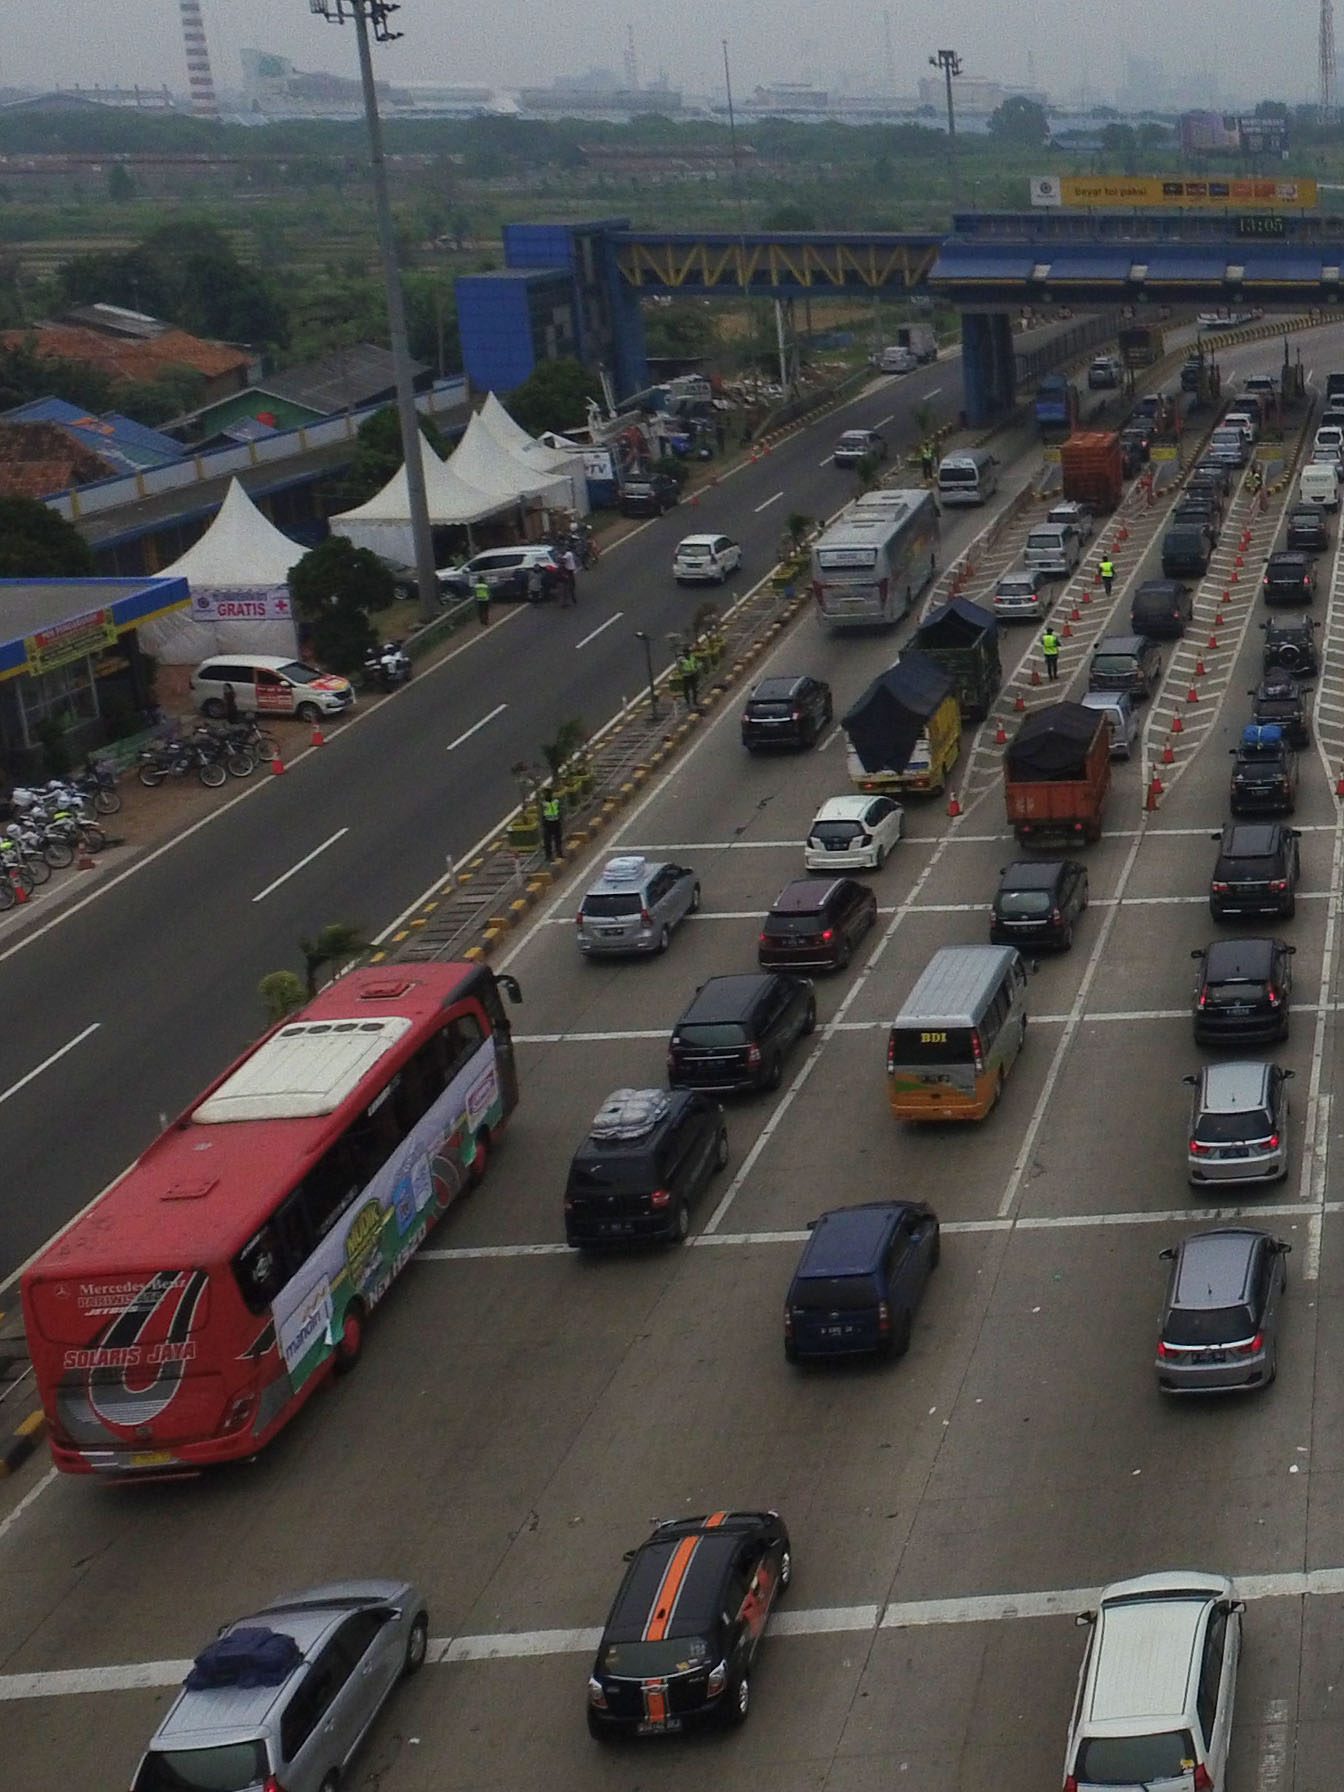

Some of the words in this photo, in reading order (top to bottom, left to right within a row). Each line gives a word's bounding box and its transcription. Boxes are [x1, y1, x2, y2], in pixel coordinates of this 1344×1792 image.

[217, 603, 266, 616] GRATIS
[921, 1033, 947, 1043] BDI
[63, 1346, 142, 1369] SOLARIS
[147, 1341, 196, 1364] JAYA
